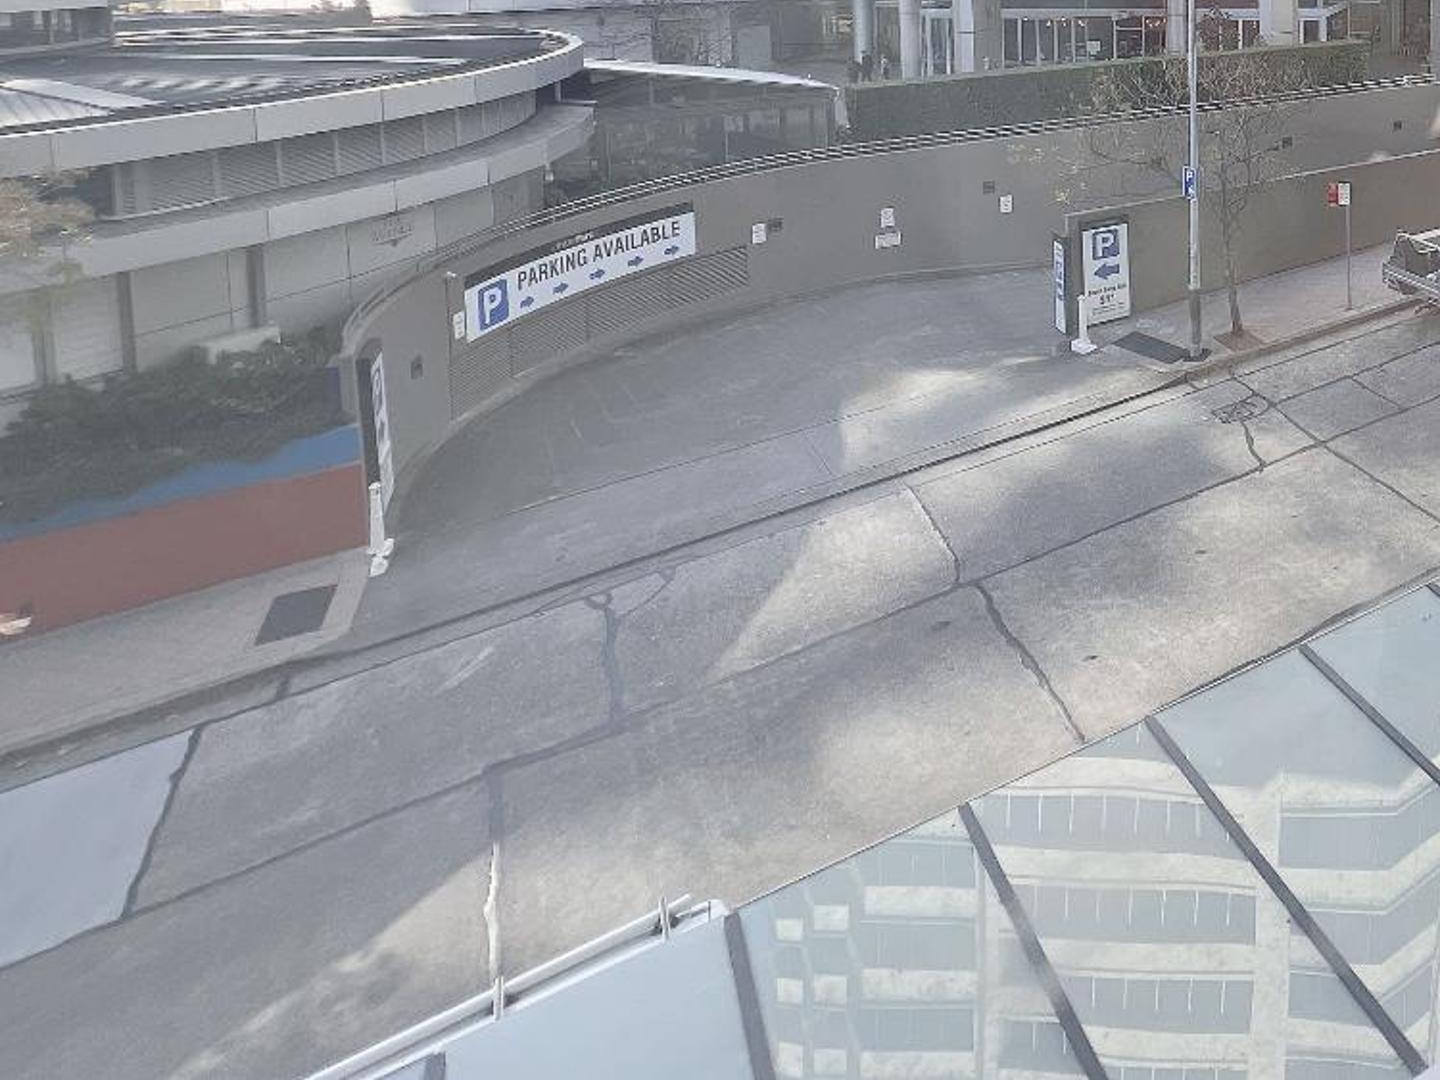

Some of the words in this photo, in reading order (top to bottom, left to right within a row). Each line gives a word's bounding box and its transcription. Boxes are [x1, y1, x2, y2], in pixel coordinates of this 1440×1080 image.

[483, 287, 502, 324] P
[518, 248, 587, 291] PARKING
[593, 221, 680, 262] AVAILABLE
[1095, 232, 1114, 258] P
